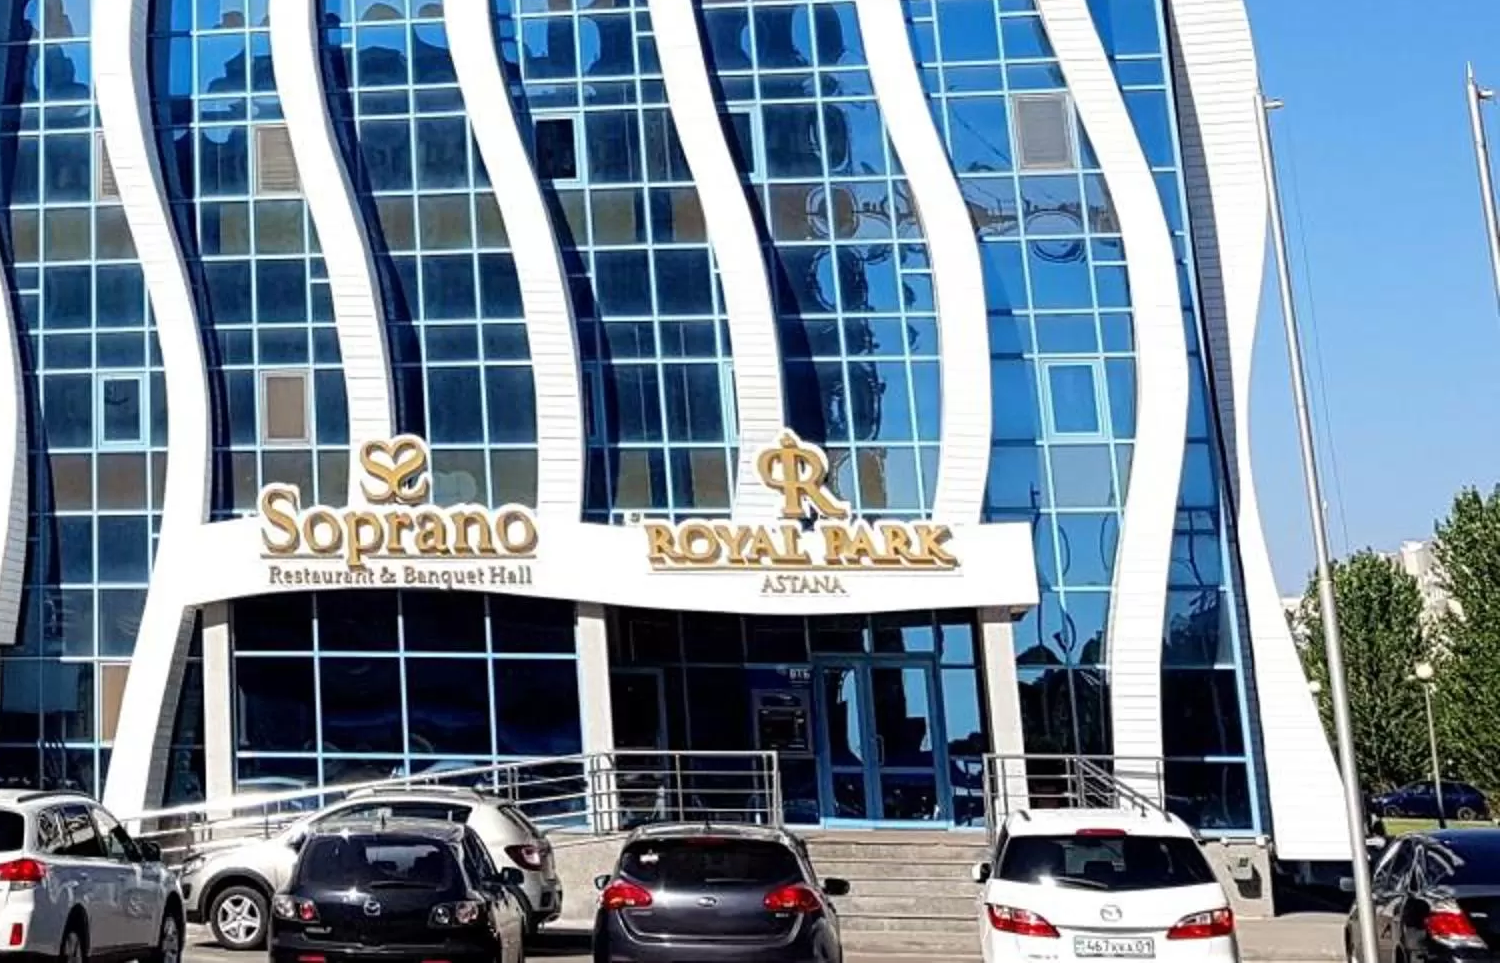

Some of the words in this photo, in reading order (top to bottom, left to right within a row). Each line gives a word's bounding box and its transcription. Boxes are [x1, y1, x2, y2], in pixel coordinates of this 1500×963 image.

[261, 487, 539, 570] Soprano
[645, 523, 812, 565] ROYAL
[822, 523, 961, 567] PARK
[269, 565, 376, 585] Restaurant
[379, 565, 398, 585] &
[403, 565, 486, 588] Banquet
[488, 565, 533, 585] Hall
[761, 574, 847, 594] ASTANA
